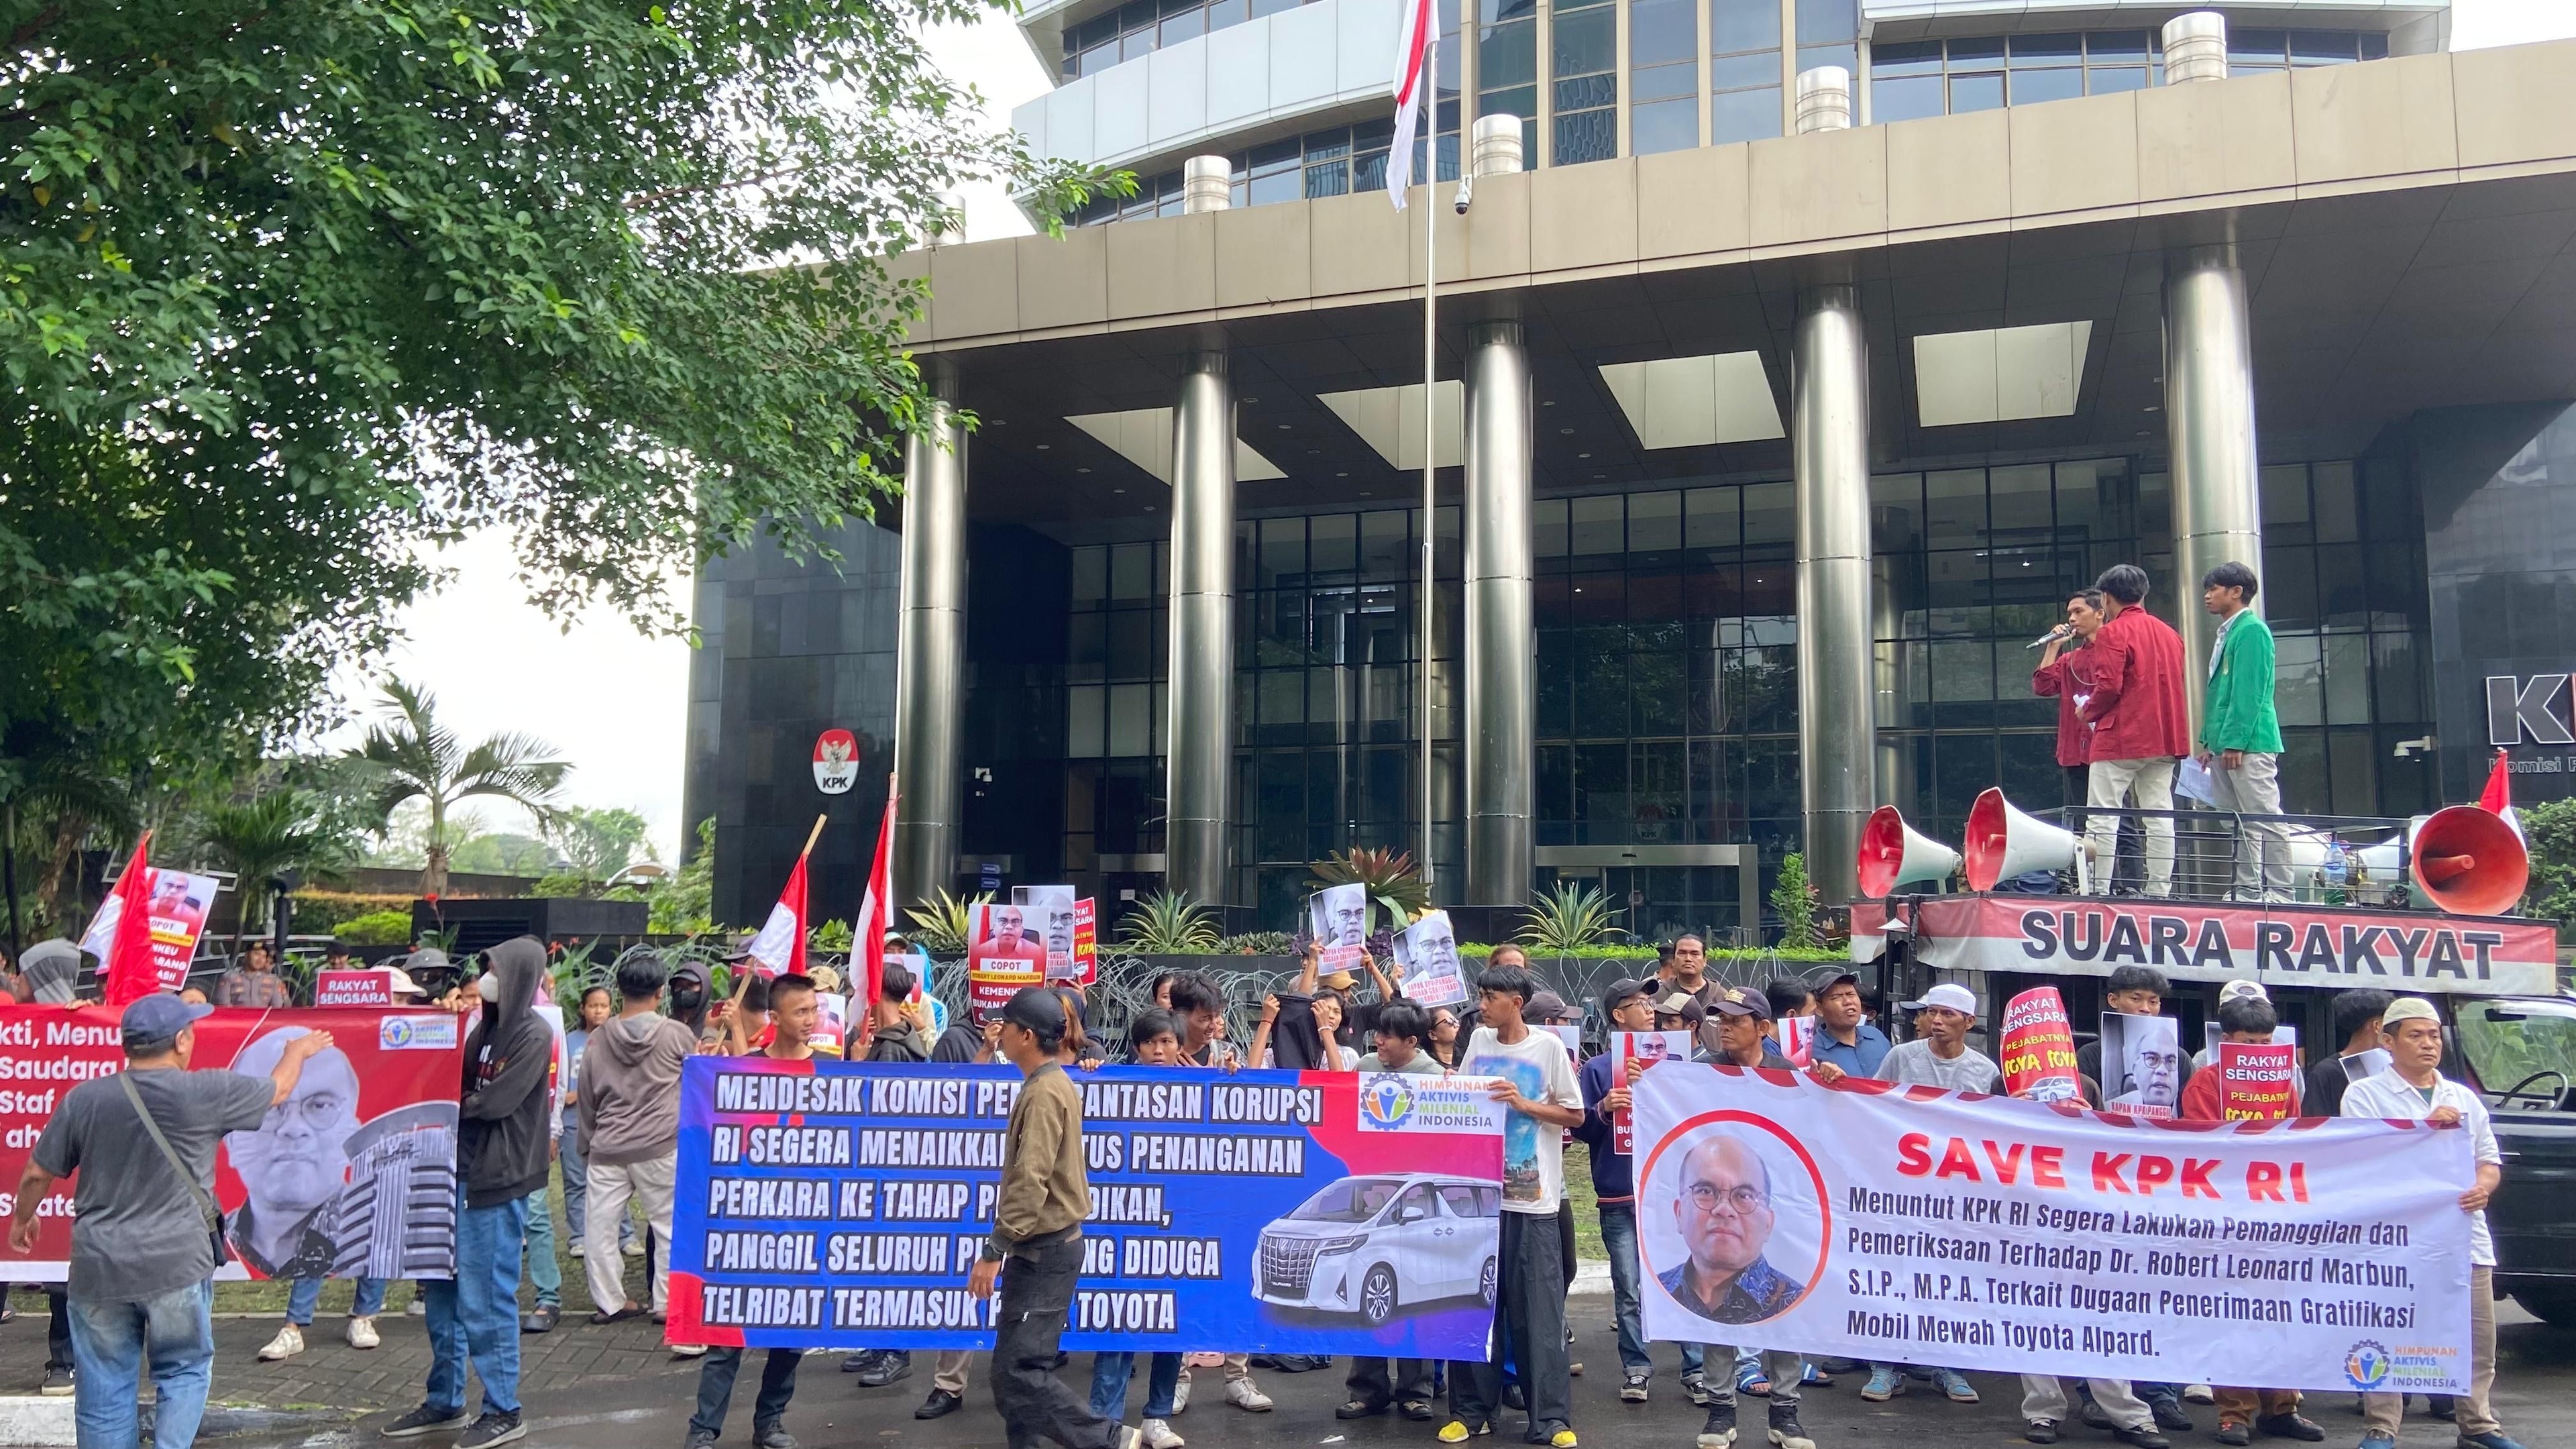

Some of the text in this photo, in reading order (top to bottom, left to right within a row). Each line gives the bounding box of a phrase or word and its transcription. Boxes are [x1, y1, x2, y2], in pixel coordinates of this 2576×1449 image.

[823, 777, 848, 788] KPK
[2020, 909, 2502, 981] SUARA RAKYAT
[991, 961, 1022, 971] COPOT
[328, 979, 378, 991] RAKYAT
[320, 992, 389, 1004] SENGSARA
[973, 998, 1000, 1009] BUKAN
[2007, 998, 2057, 1020] RAKYAT
[2002, 1011, 2068, 1036] SENGSARA
[2006, 1034, 2072, 1053] PEJABATNYA
[2237, 1055, 2289, 1067] RAKYAT
[2225, 1068, 2292, 1081] SENGSARA
[0, 1087, 55, 1115] Staf
[716, 1074, 863, 1113] MENDESAK
[871, 1079, 967, 1115] KOMISI
[1211, 1086, 1321, 1123] KORUPSI
[1419, 1091, 1470, 1103] AKTIVIS
[1419, 1103, 1479, 1114] MILENIAL
[2111, 1101, 2132, 1114] KAPAN
[1419, 1116, 1493, 1128] INDONESIA
[712, 1126, 741, 1163] RI
[749, 1128, 851, 1165] SEGERA
[1131, 1135, 1303, 1174] PENANGANAN
[1896, 1132, 2311, 1204] SAVE KPK RI
[709, 1179, 830, 1218] PERKARA
[839, 1181, 873, 1219] KE
[883, 1183, 969, 1220] TAHAP
[1849, 1186, 2409, 1247] Menuntut KPK RI Segera Lakukan Pemanggilan dan
[706, 1232, 818, 1271] PANGGIL
[828, 1234, 948, 1273] SELURUH
[1124, 1239, 1220, 1276] DIDUGA
[1848, 1226, 2415, 1291] Pemeriksaan Terhadap Dr. Robert Leonard Marbun,
[1849, 1269, 2415, 1329] S.I.P., M.P.A. Terkait Dugaan Penerimaan Gratifikasi
[704, 1286, 824, 1326] TELRIBAT
[833, 1289, 978, 1327] TERMASUK
[1077, 1292, 1175, 1330] TOYOTA
[1847, 1309, 2160, 1357] Mobil Mewah Toyota Alpard.
[2395, 1346, 2458, 1356] HIMPUNAN
[2394, 1356, 2436, 1366] AKTIVIS
[2393, 1366, 2446, 1377] MILENIAL
[2393, 1377, 2457, 1388] INDONESIA
